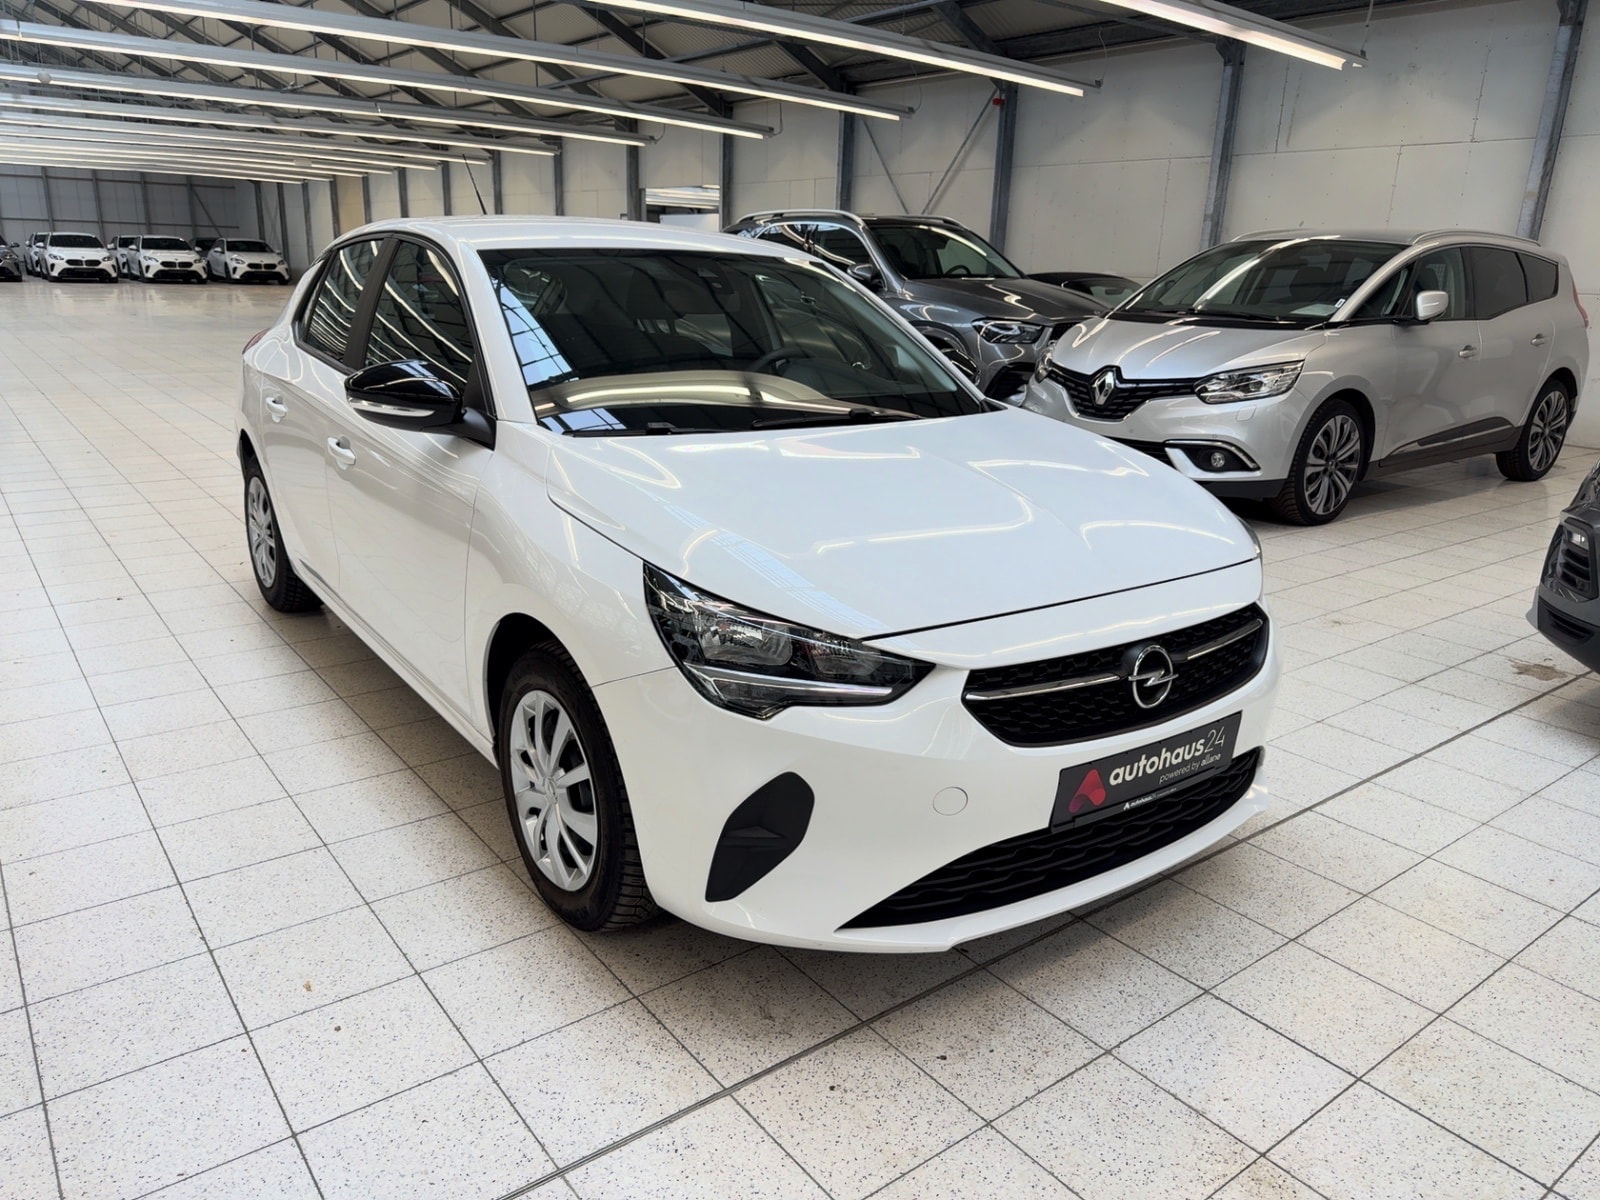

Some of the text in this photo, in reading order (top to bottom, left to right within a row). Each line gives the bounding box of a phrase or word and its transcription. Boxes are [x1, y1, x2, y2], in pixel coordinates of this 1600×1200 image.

[1109, 726, 1225, 786] autohaus24
[1159, 753, 1221, 784] powered by allane
